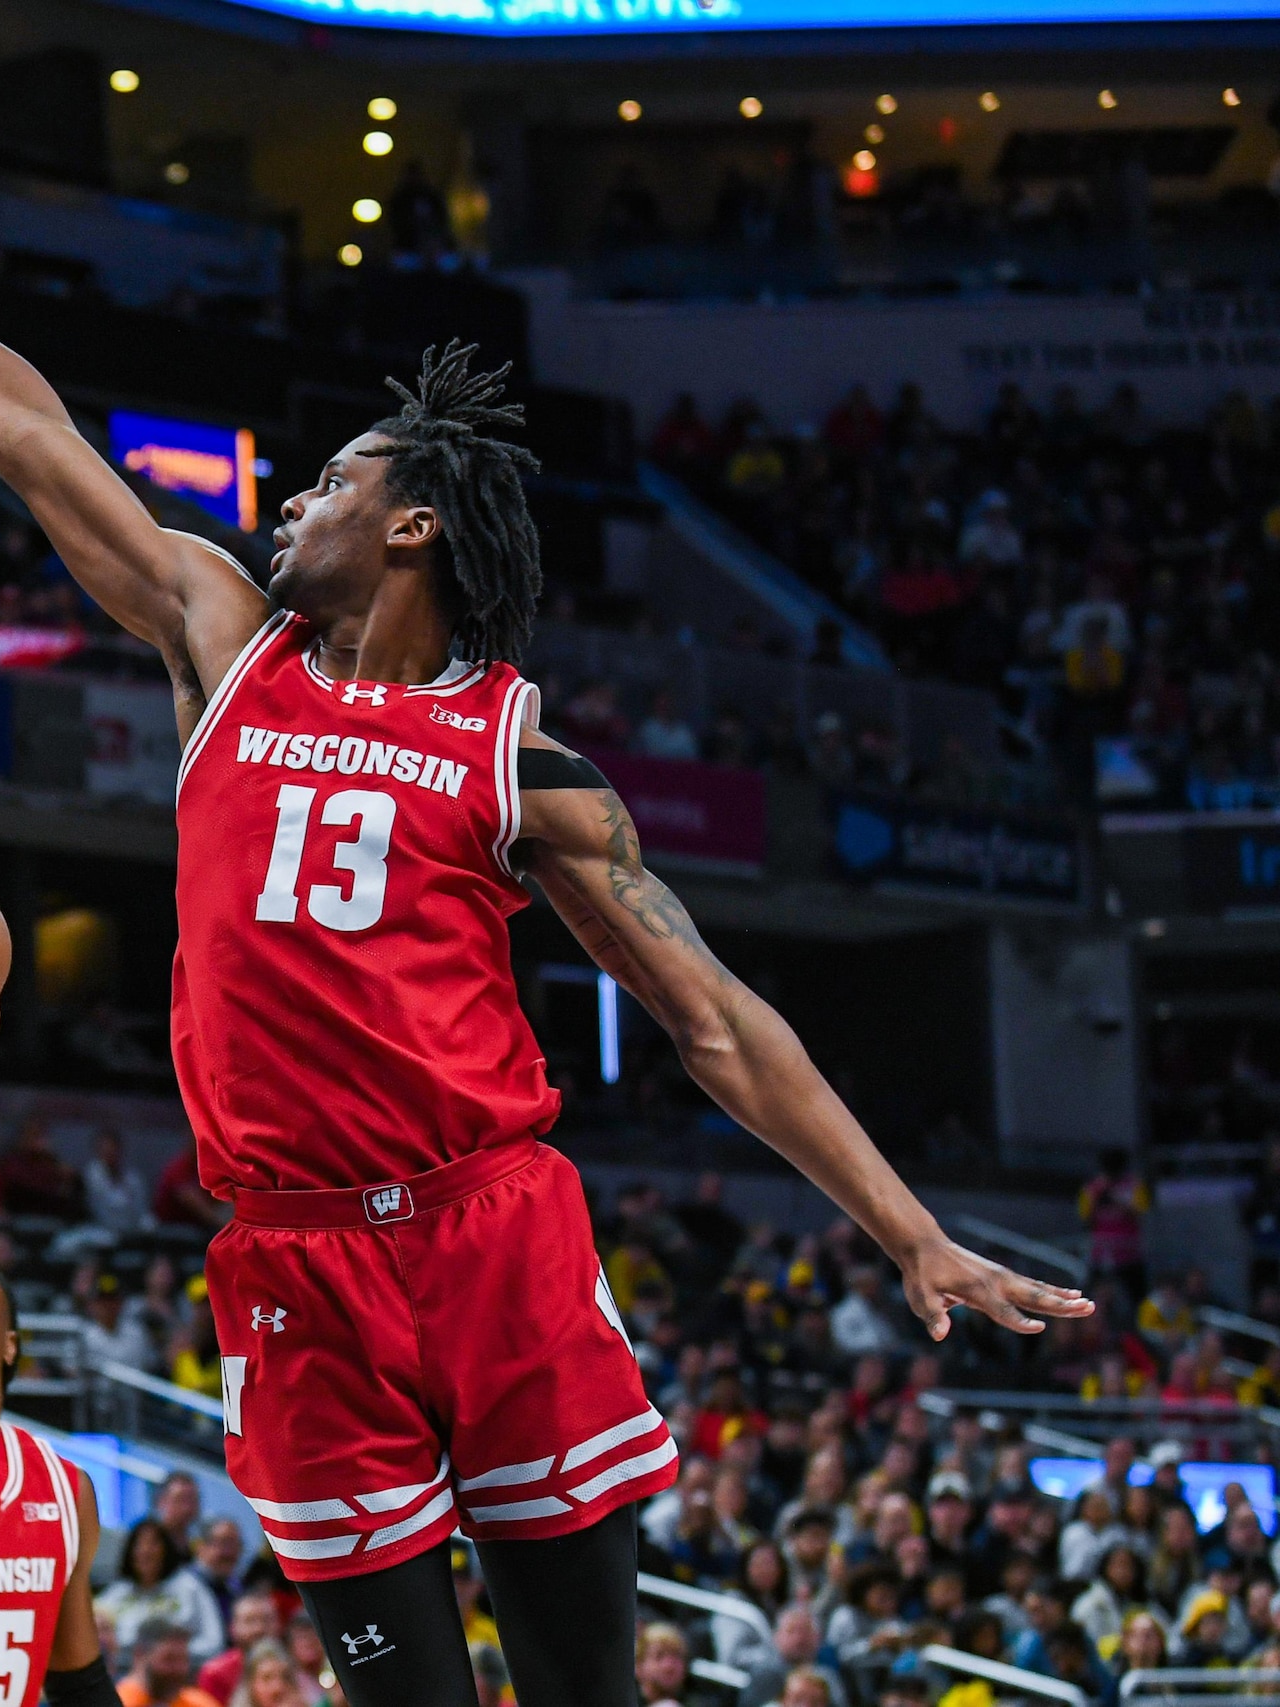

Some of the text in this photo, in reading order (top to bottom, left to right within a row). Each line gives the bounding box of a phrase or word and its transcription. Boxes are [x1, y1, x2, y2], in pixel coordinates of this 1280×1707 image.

[235, 724, 469, 799] WISCONSIN
[254, 783, 397, 932] 13
[349, 1644, 397, 1667] UNDER ARMOUR
